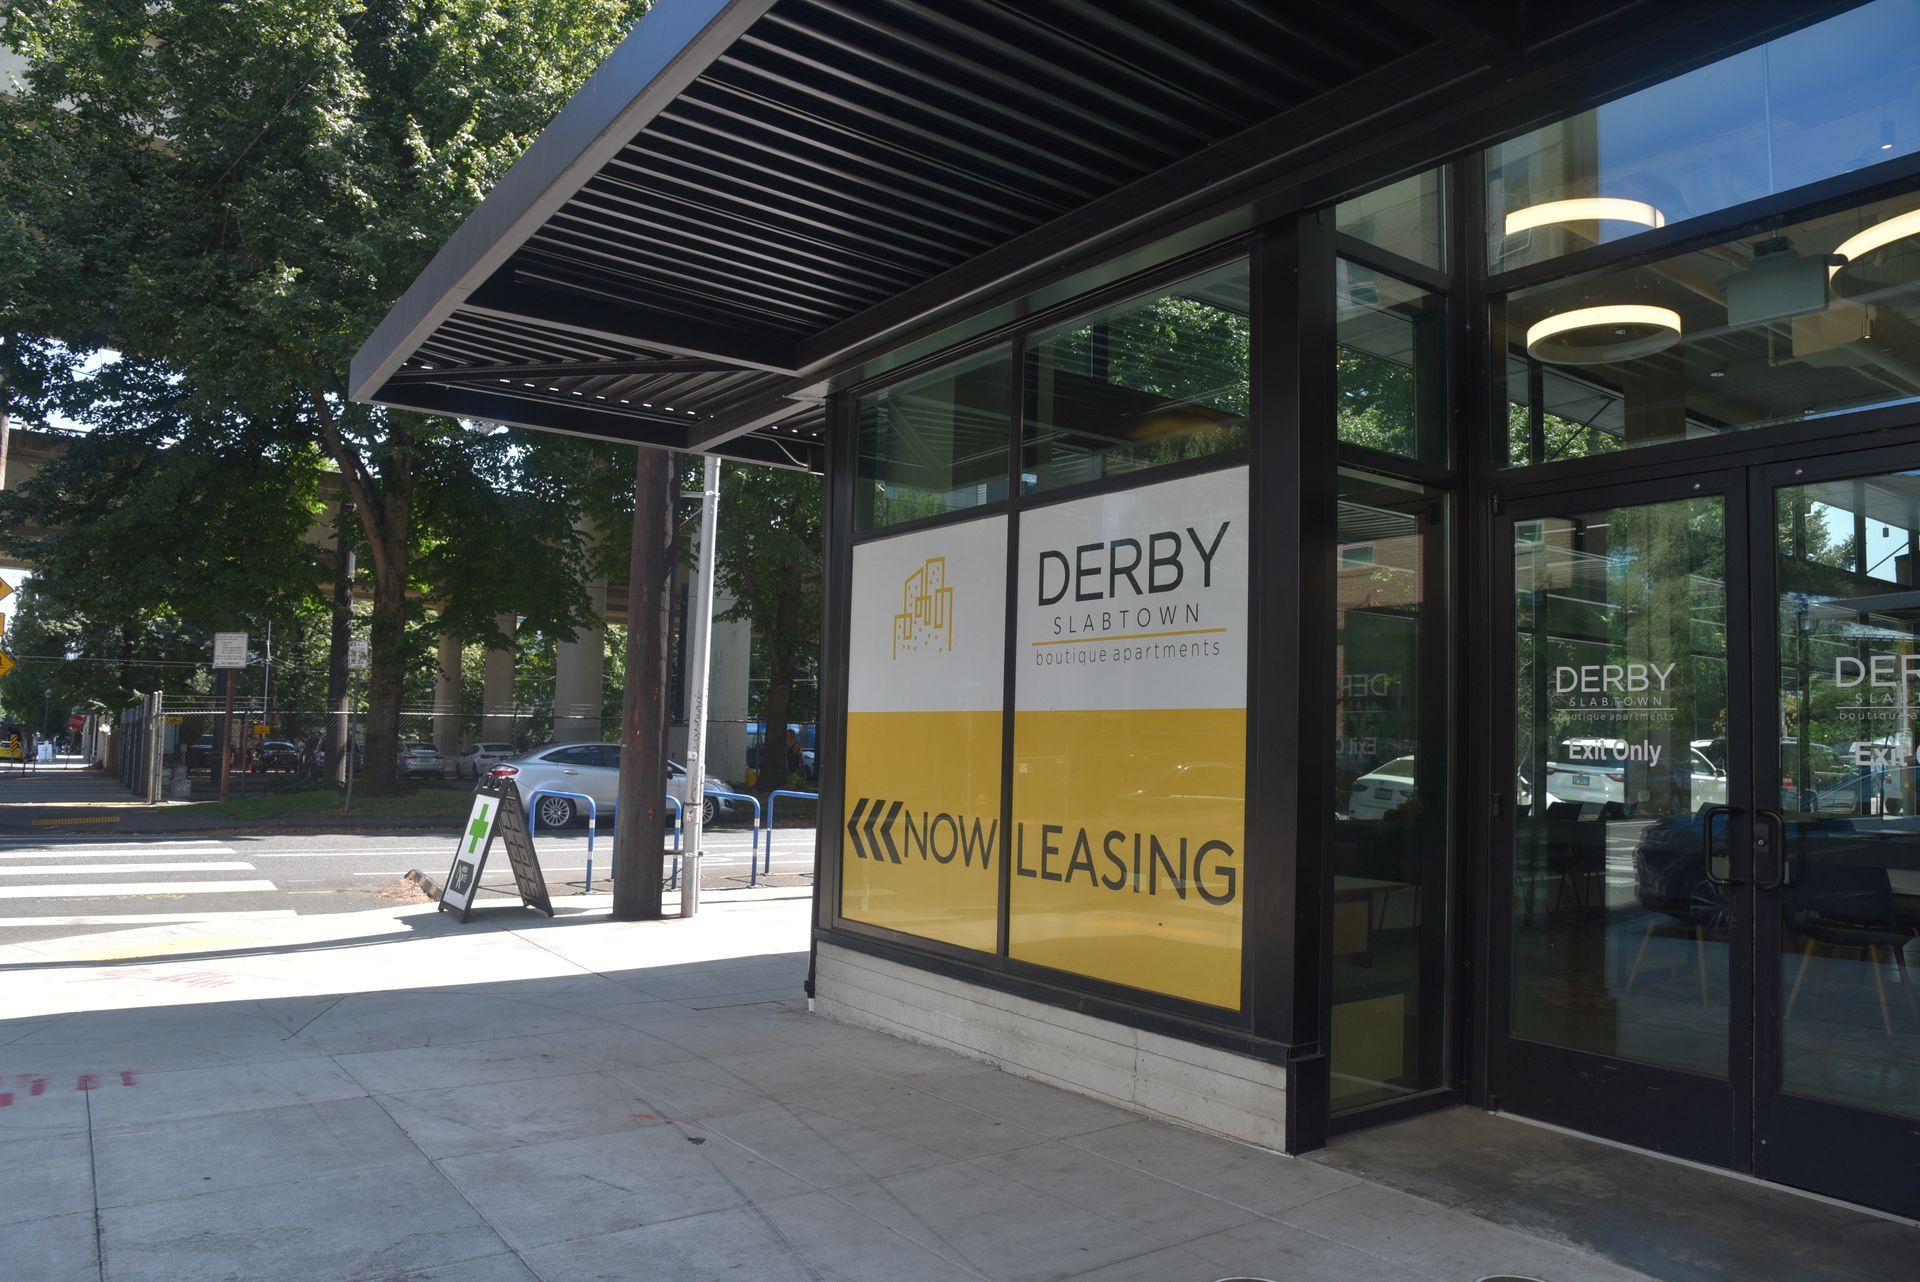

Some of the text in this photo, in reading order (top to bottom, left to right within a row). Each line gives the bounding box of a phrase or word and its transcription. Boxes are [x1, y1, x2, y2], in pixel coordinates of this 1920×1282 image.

[1038, 521, 1231, 607] DERBY
[1053, 603, 1199, 635] SLABTOWN
[1035, 639, 1221, 667] boutique apartments
[1556, 662, 1677, 693] DERBY
[1569, 696, 1663, 707] SLABTOWN
[1609, 712, 1675, 721] apartments
[1568, 738, 1662, 767] Exit Only
[1854, 741, 1908, 767] Exit
[903, 809, 1237, 906] NOW LEASING
